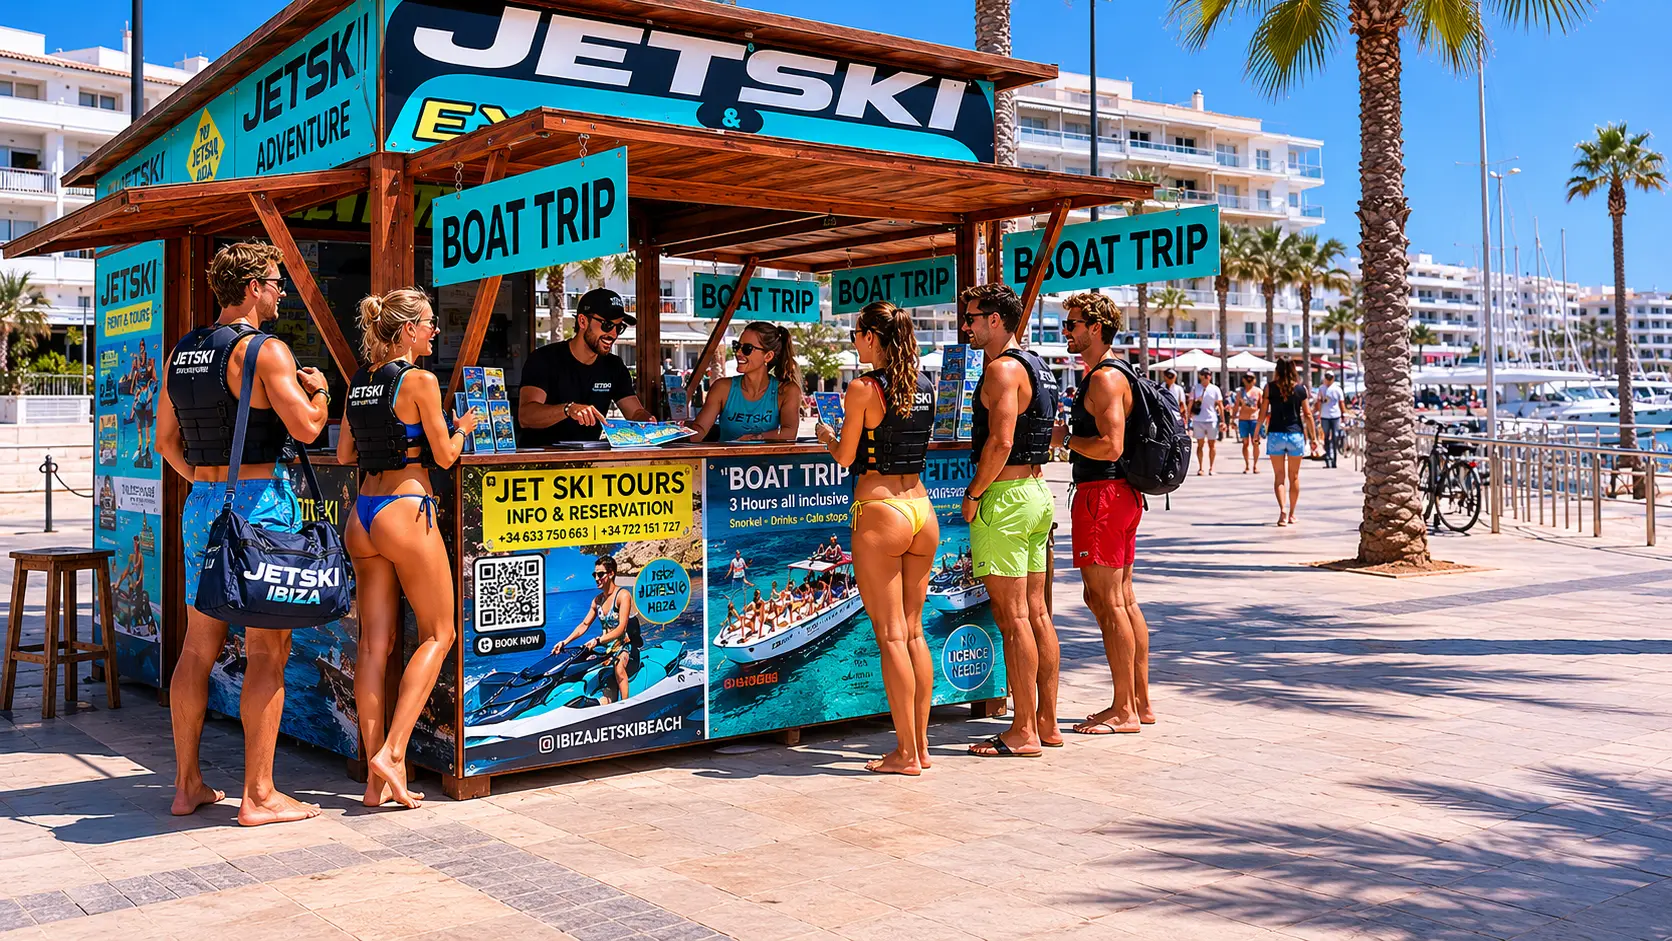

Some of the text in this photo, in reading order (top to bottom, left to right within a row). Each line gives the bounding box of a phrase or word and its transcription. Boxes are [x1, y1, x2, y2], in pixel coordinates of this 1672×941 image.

[411, 5, 969, 131] JETSKI
[256, 100, 350, 175] ADVENTURE
[442, 198, 526, 269] BOAT
[534, 177, 616, 249] TRIP
[1129, 223, 1209, 271] TRIP
[101, 259, 157, 307] JETSKI
[839, 267, 950, 306] BOAT TRIP
[768, 287, 814, 314] TRIP
[173, 349, 215, 365] JETSKI
[349, 384, 384, 399] JETSKI
[727, 411, 773, 424] JETSKI
[495, 471, 685, 503] JET SKI TOURS
[800, 462, 850, 487] TRIP
[507, 500, 673, 525] INFO & RESERVATION
[729, 492, 849, 511] 3 Hours all inclusive
[498, 521, 681, 543] +34 633 750 663 +34 722 151 727
[729, 517, 762, 528] Snorkel
[771, 514, 798, 525] Drinks
[825, 512, 848, 524] stops
[243, 562, 340, 588] JETSKI
[266, 585, 321, 605] IBIZA
[494, 634, 540, 649] BOOK NOW
[948, 647, 989, 664] LICENCE
[952, 662, 988, 678] NEEDED
[556, 715, 682, 749] IBIZAJETSKIBEACH
